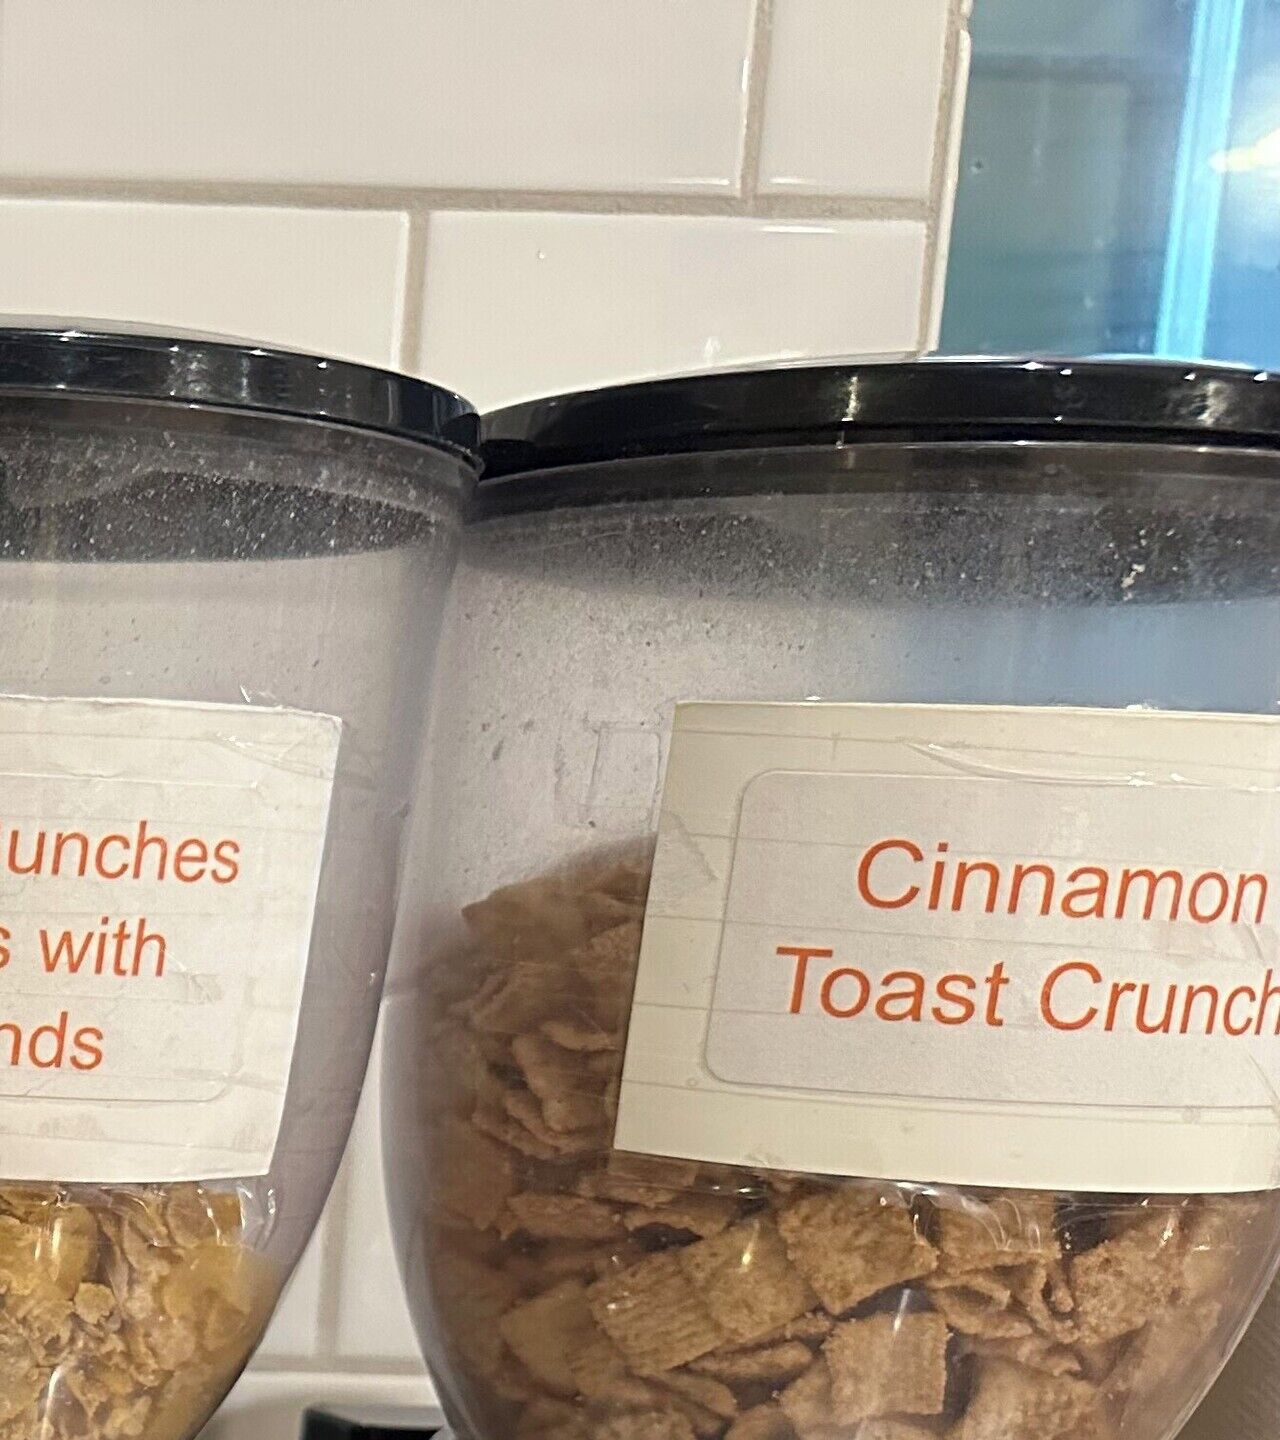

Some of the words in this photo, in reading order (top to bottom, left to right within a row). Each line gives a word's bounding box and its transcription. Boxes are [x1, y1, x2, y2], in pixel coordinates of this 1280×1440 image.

[855, 837, 1270, 926] Cinnamon
[38, 917, 168, 979] with
[775, 944, 1011, 1029] Toast
[1038, 960, 1280, 1037] Crunch
